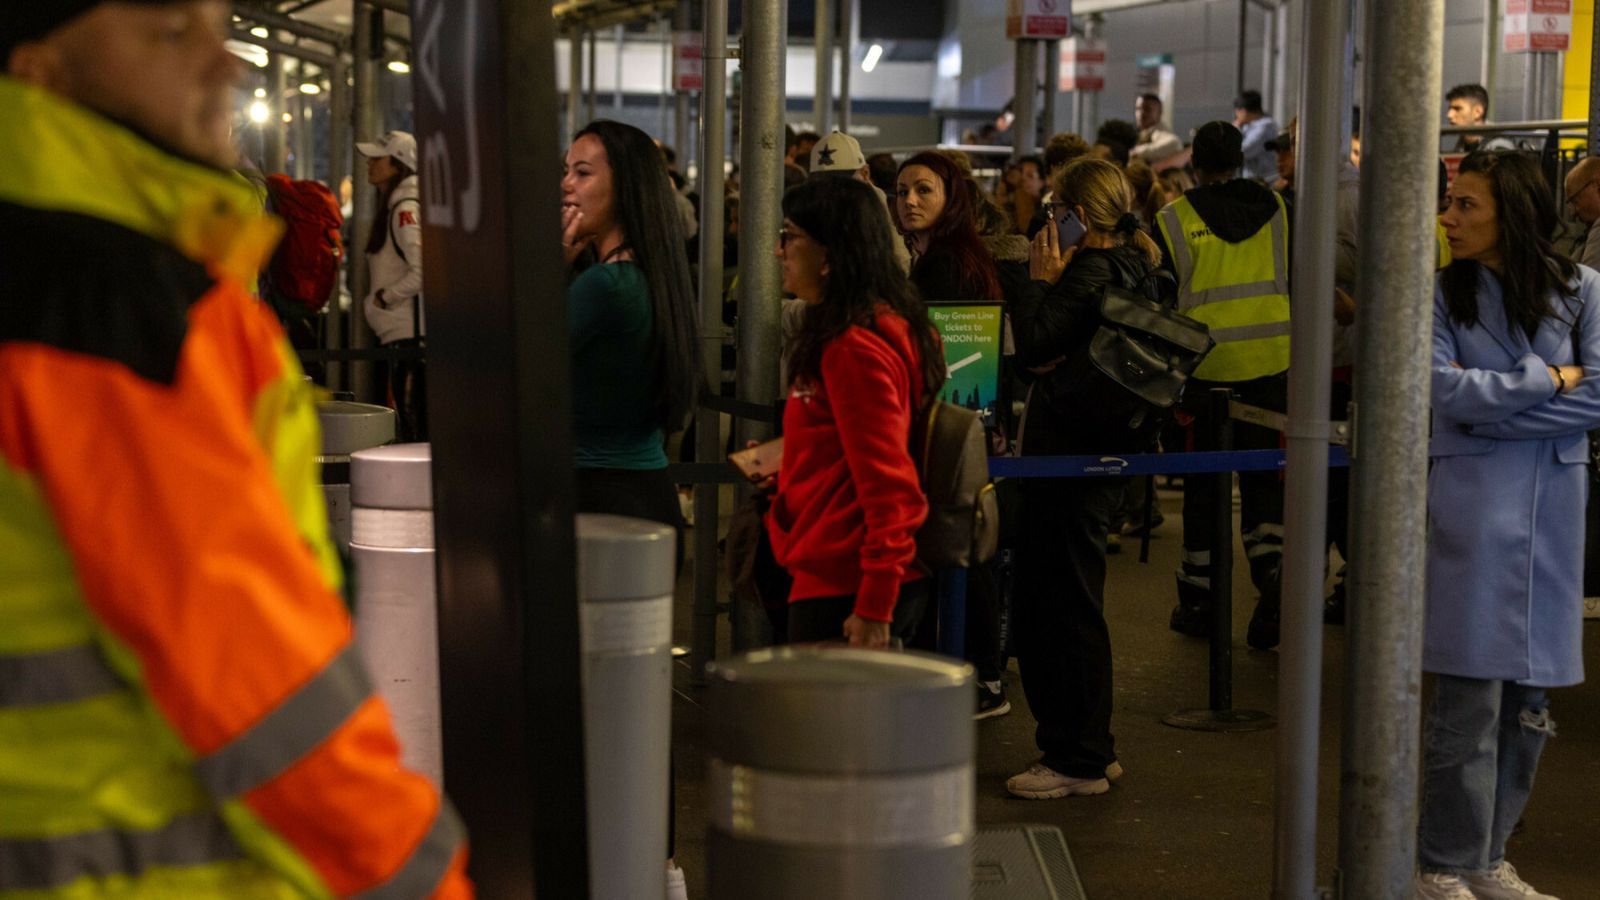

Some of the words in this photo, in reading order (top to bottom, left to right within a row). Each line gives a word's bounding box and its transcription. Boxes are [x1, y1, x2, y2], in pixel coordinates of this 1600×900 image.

[416, 0, 455, 227] BA
[934, 312, 950, 322] Buy
[952, 311, 976, 320] Green
[978, 311, 995, 320] Line
[945, 323, 971, 332] tickets
[974, 324, 983, 332] to
[941, 334, 972, 343] ONDON
[974, 334, 992, 343] here
